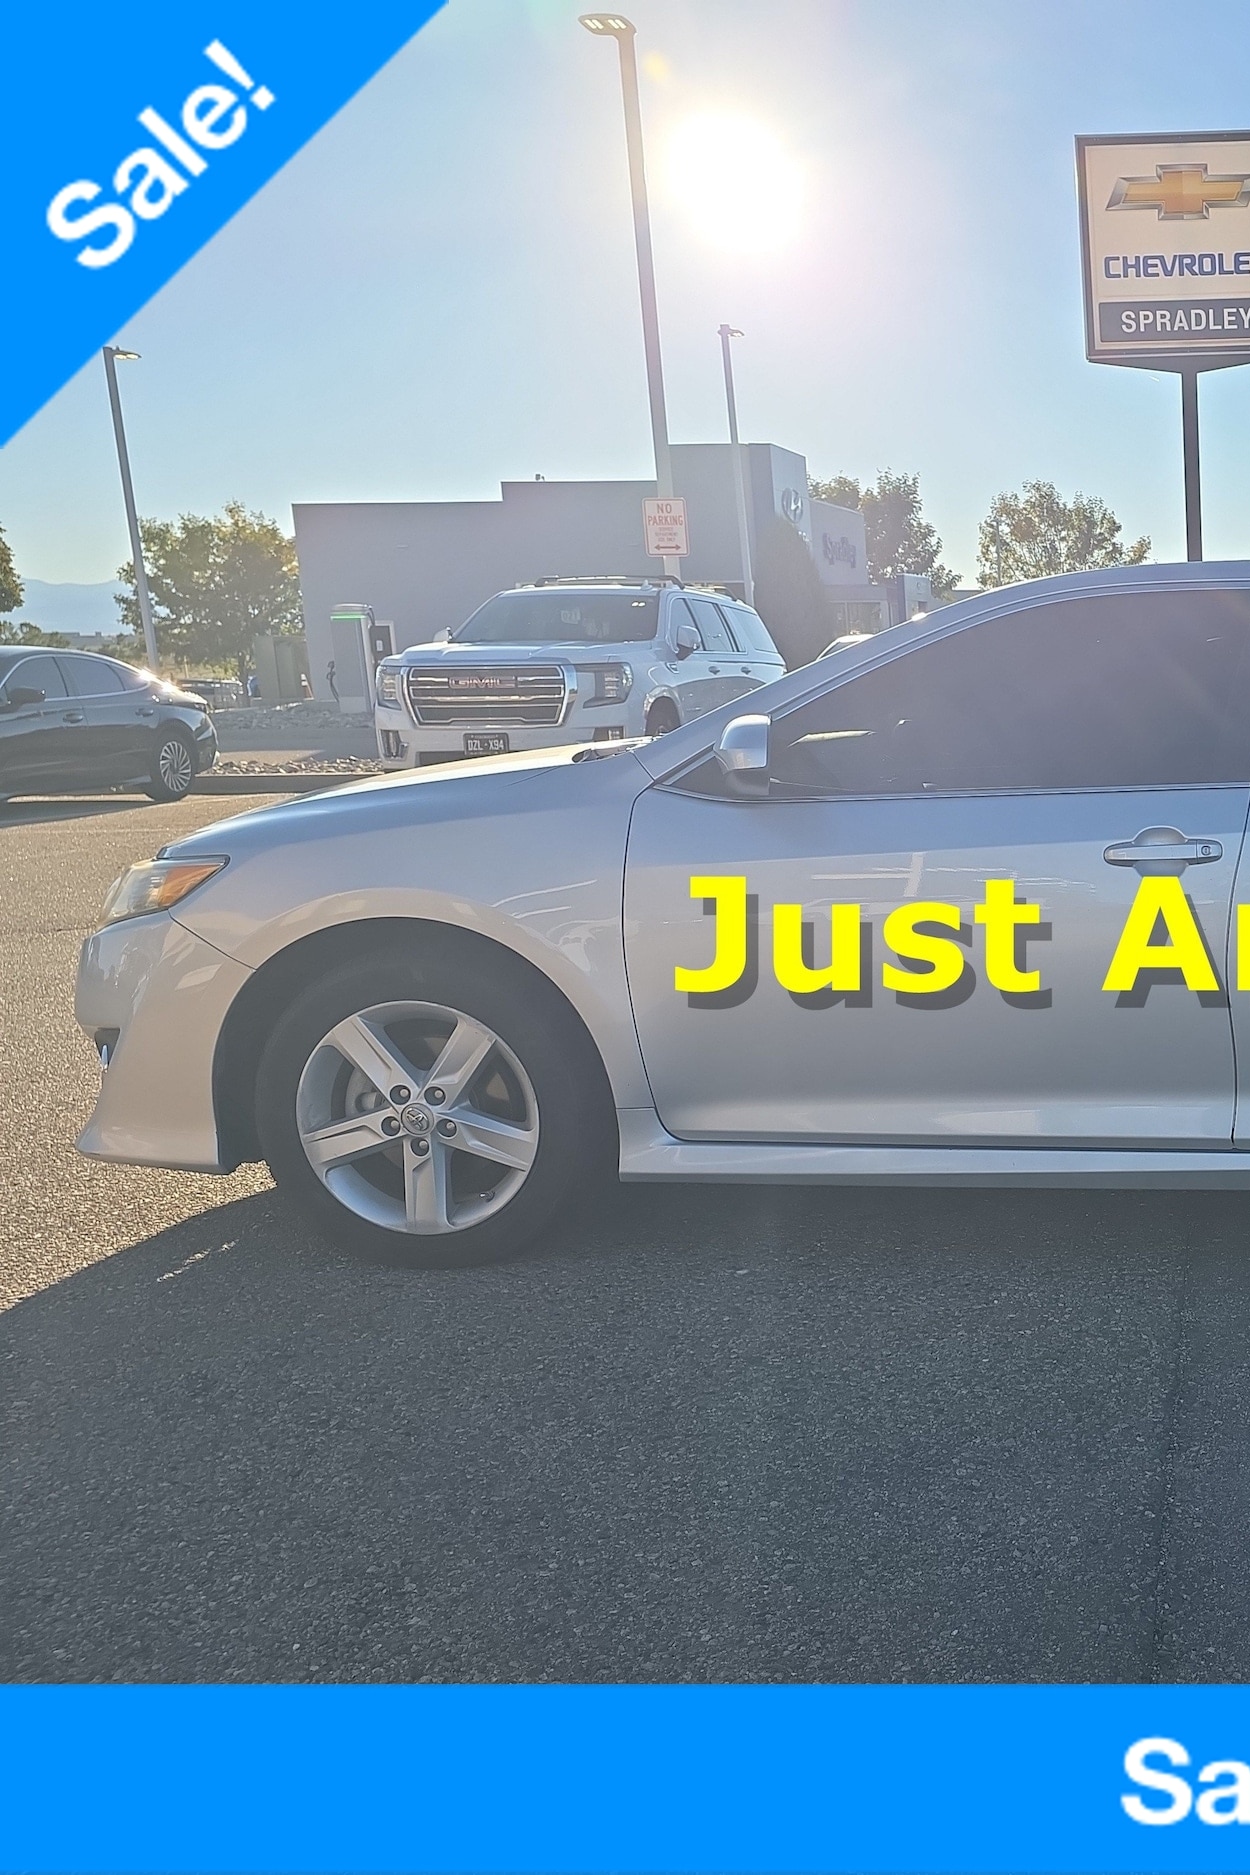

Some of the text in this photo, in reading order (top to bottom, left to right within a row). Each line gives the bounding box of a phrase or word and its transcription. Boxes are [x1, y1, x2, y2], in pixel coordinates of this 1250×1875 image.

[656, 503, 673, 514] NO
[647, 515, 684, 526] PARKING
[448, 676, 516, 689] GMC
